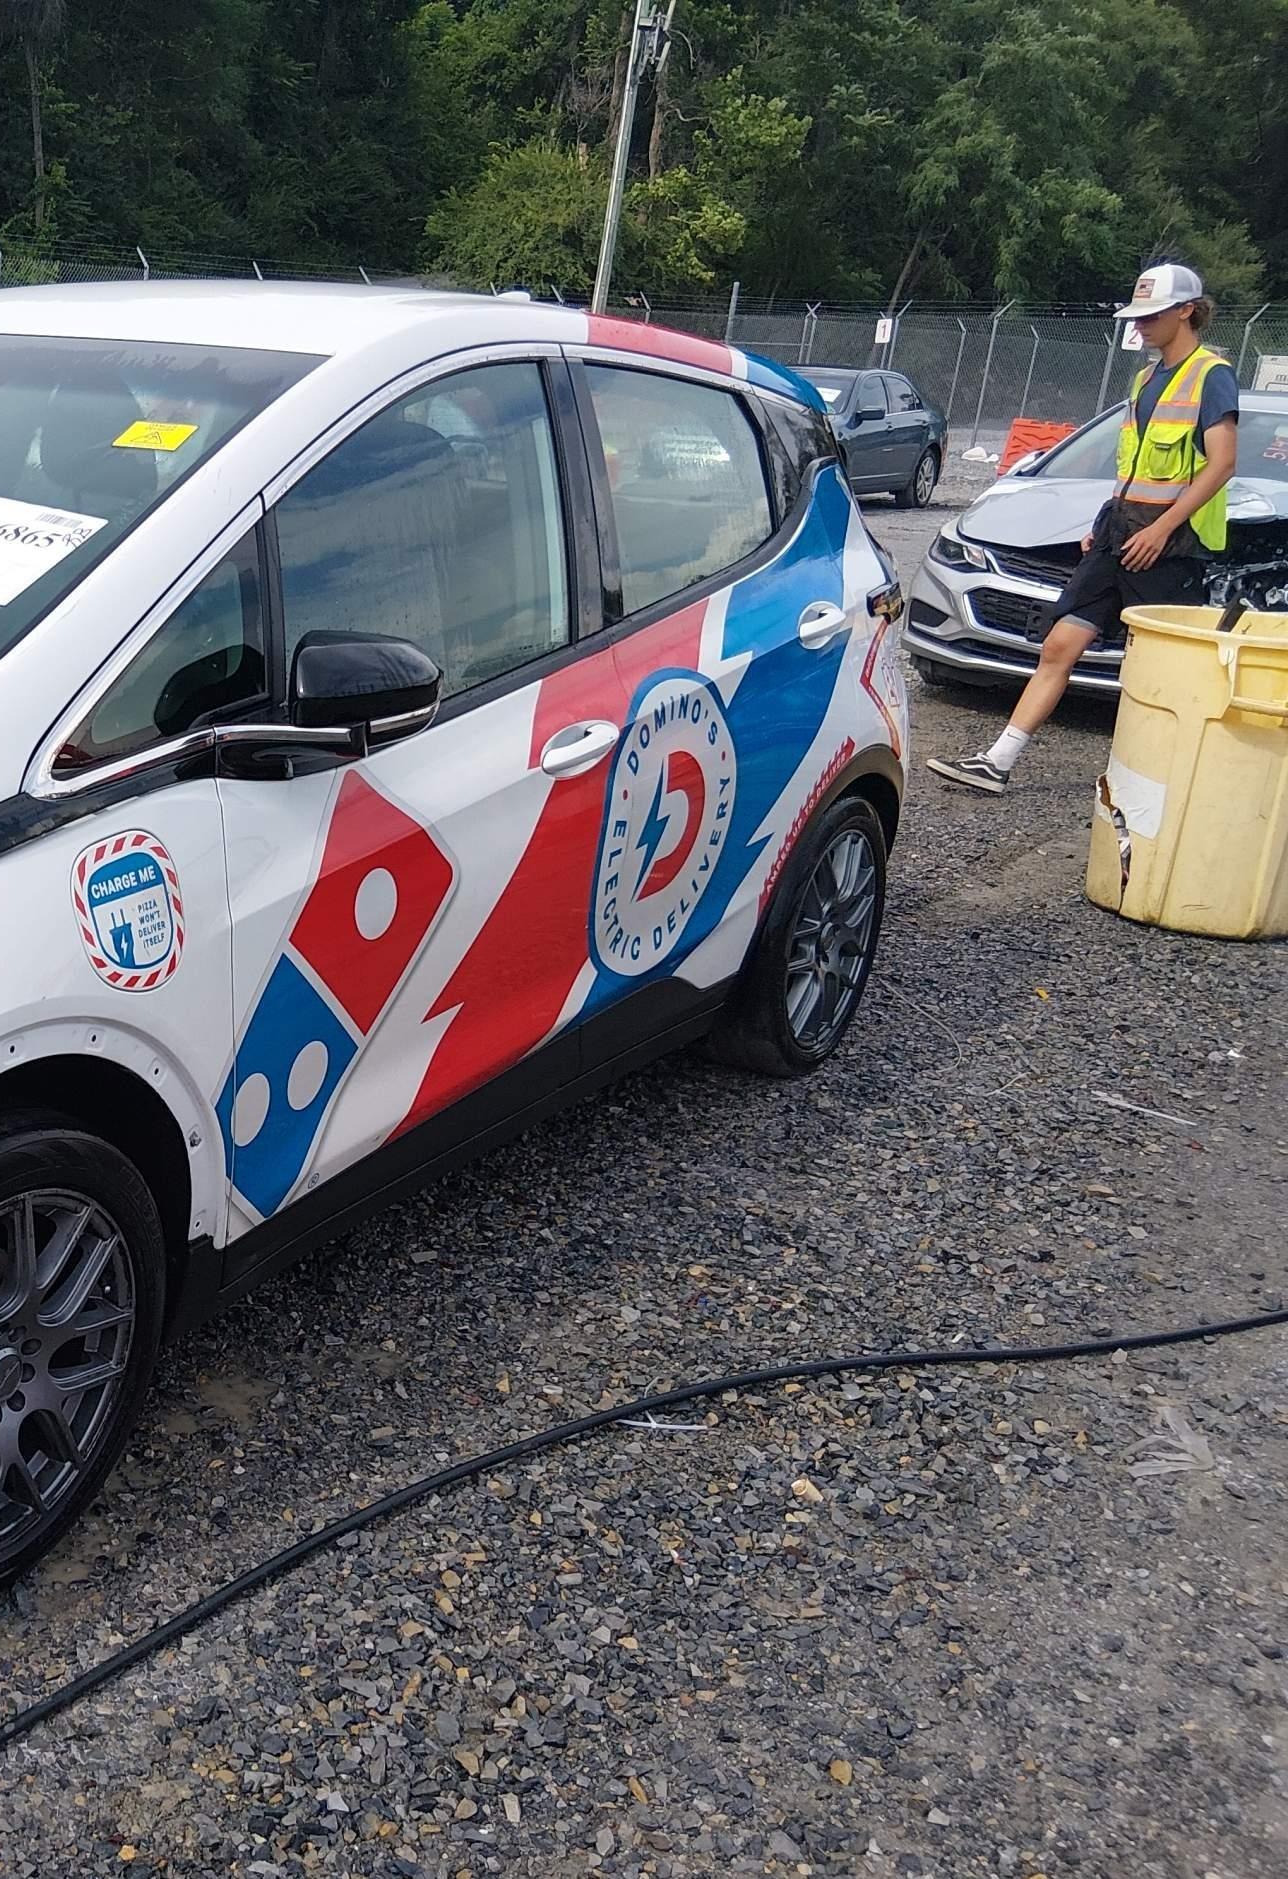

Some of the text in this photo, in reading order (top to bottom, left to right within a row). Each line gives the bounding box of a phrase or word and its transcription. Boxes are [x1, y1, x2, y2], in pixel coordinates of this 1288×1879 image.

[881, 324, 887, 339] 1
[1127, 328, 1139, 345] 2
[626, 693, 718, 776] DOMINO'S
[815, 751, 847, 796] DELIVER
[602, 777, 731, 961] ELECTRIC DELIVERY
[90, 865, 157, 900] CHARGE ME
[137, 899, 157, 913] PIZZA
[138, 910, 161, 924] WON'T
[138, 920, 166, 938] DELIVER
[143, 932, 165, 949] ITSELF
